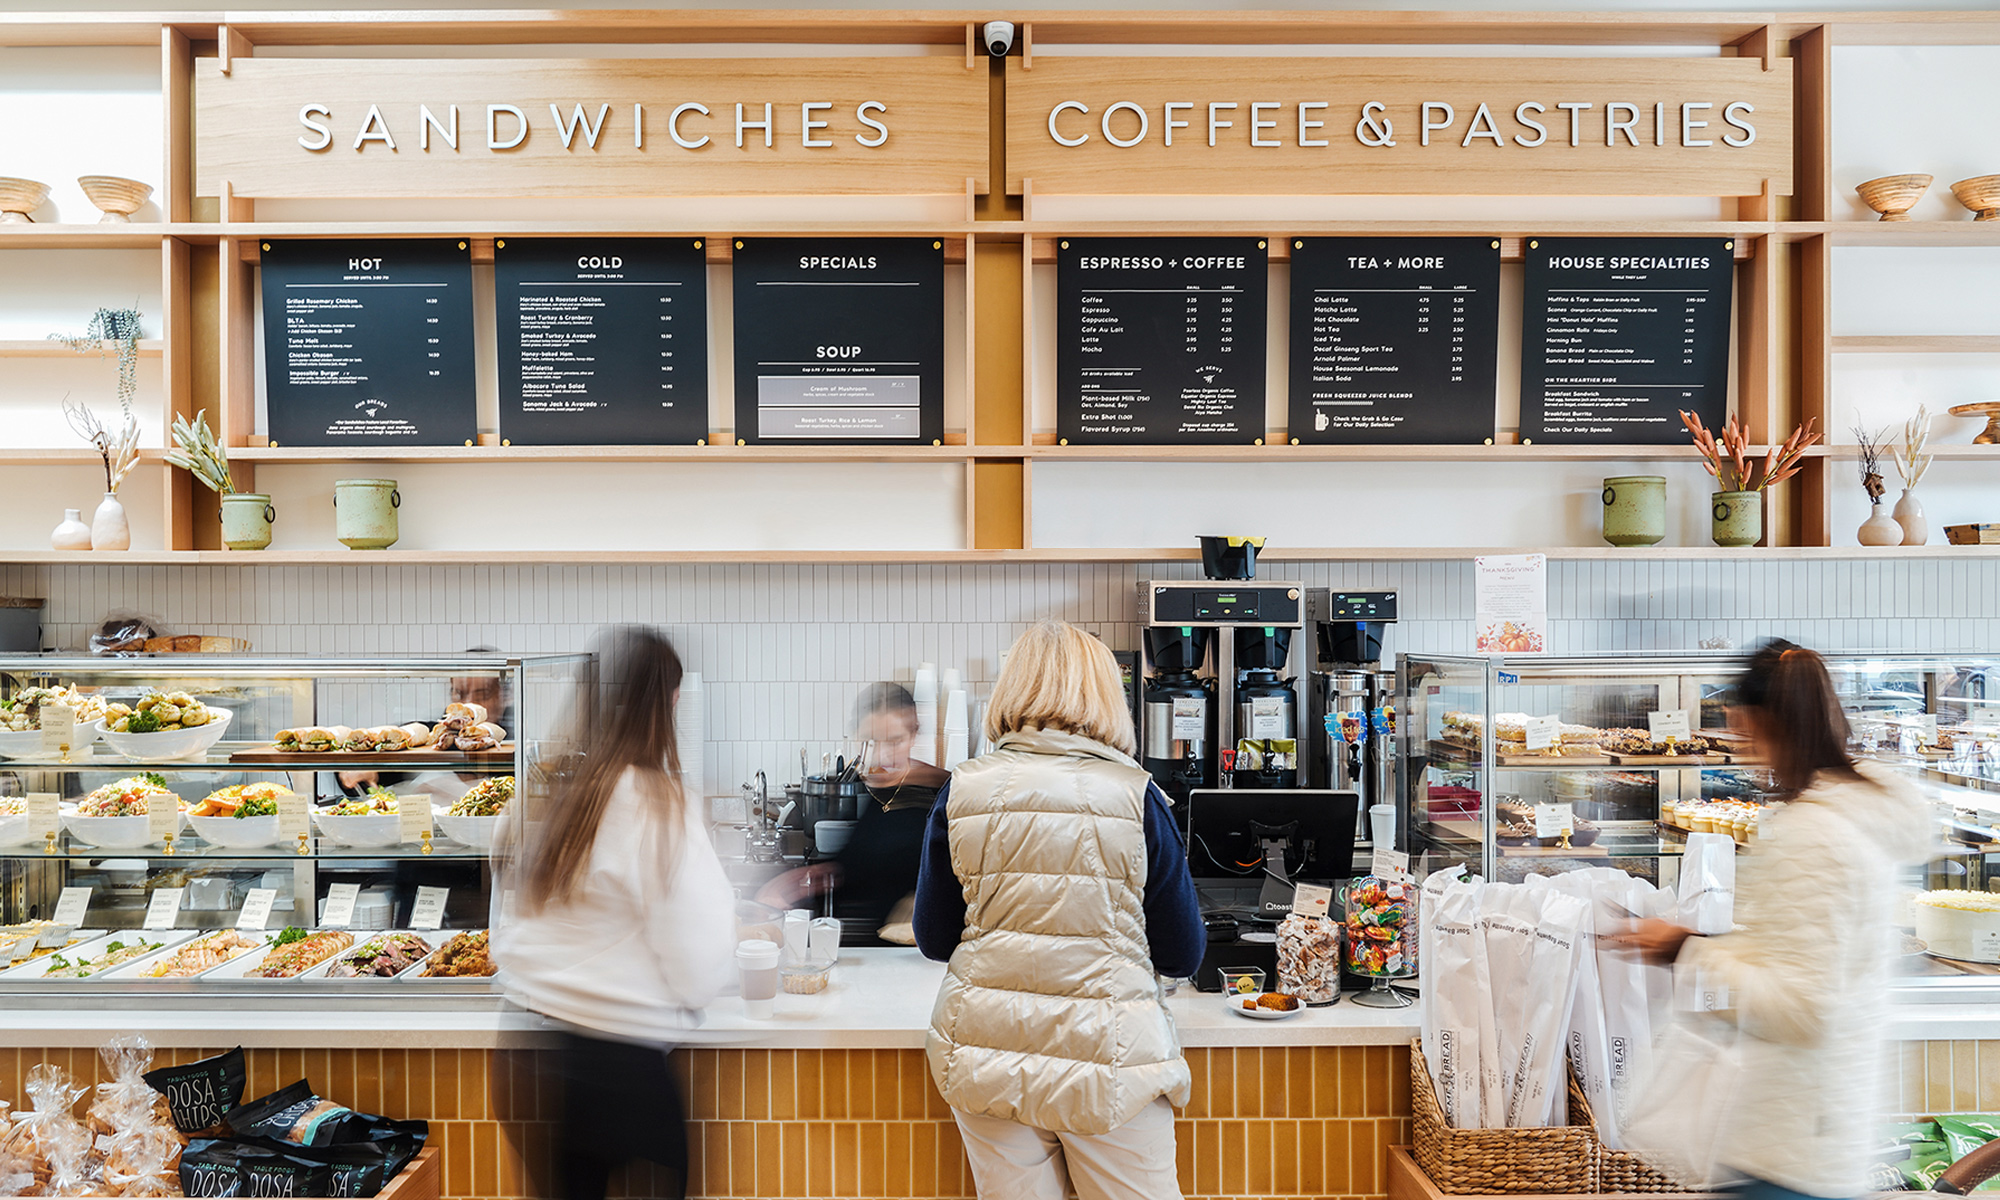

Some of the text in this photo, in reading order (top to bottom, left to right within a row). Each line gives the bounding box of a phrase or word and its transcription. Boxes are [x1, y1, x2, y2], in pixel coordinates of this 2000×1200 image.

[298, 101, 889, 151] SANDWICHES
[1047, 101, 1758, 148] COFFEE & PASTRIES
[349, 258, 382, 270] HOT
[578, 257, 622, 269] COLD
[800, 257, 877, 269] SPECIALS
[1081, 257, 1245, 269] ESPRESSO + COFFEE
[1348, 257, 1444, 269] TEA + MORE
[1549, 257, 1710, 269] HOUSE SPECIALTIES
[816, 346, 861, 358] SOUP
[1482, 566, 1535, 574] THANKSGIVING
[1334, 725, 1366, 734] iced tea
[1273, 902, 1294, 911] toast
[1442, 1032, 1451, 1072] BREAD
[1614, 1039, 1625, 1077] BREAD
[167, 1077, 216, 1109] DOSA
[190, 1169, 239, 1198] DOSA
[250, 1172, 294, 1198] DOSA
